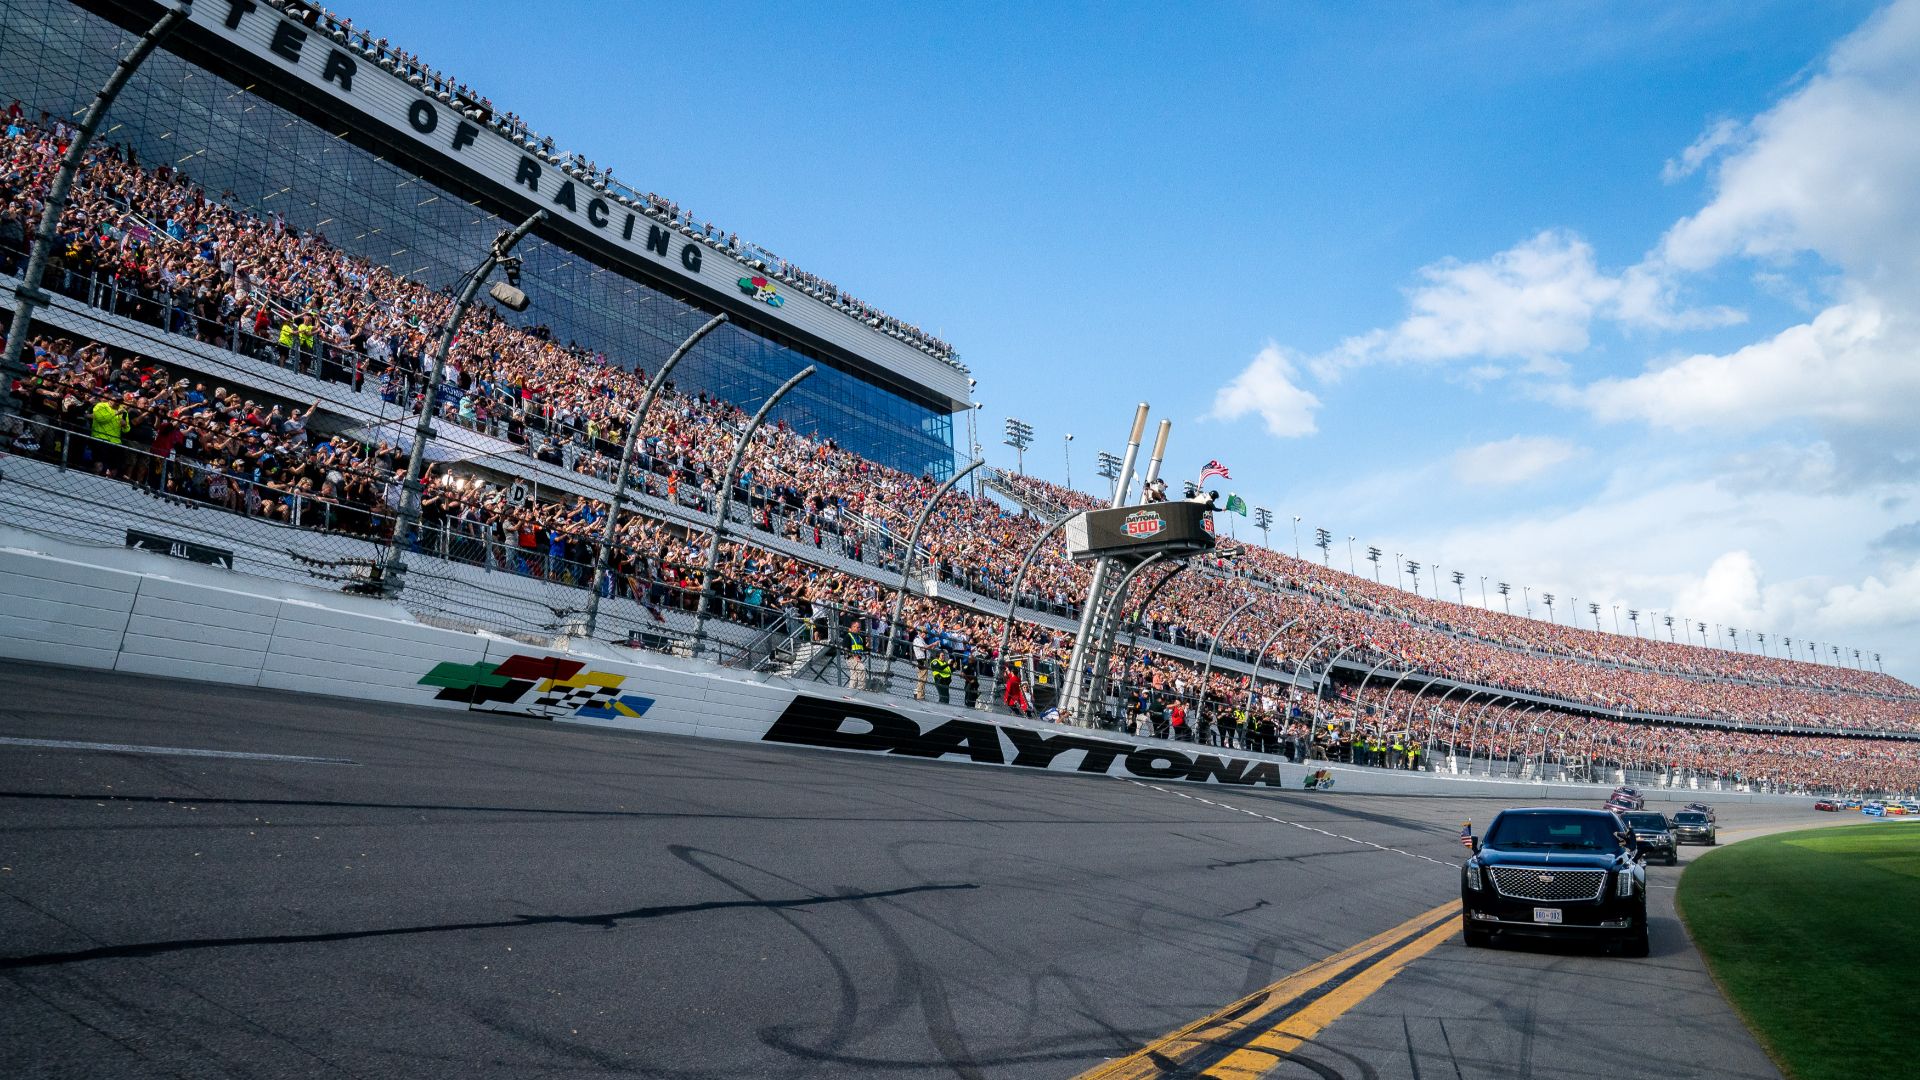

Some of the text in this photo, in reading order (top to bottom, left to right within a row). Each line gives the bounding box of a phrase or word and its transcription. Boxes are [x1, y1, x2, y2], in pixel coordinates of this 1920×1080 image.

[181, 0, 703, 273] TER OF RACING
[514, 486, 524, 501] D
[1127, 514, 1159, 522] DAYTONA
[1128, 520, 1158, 534] 500
[170, 543, 190, 559] ALL
[762, 695, 1282, 787] DAYTONA
